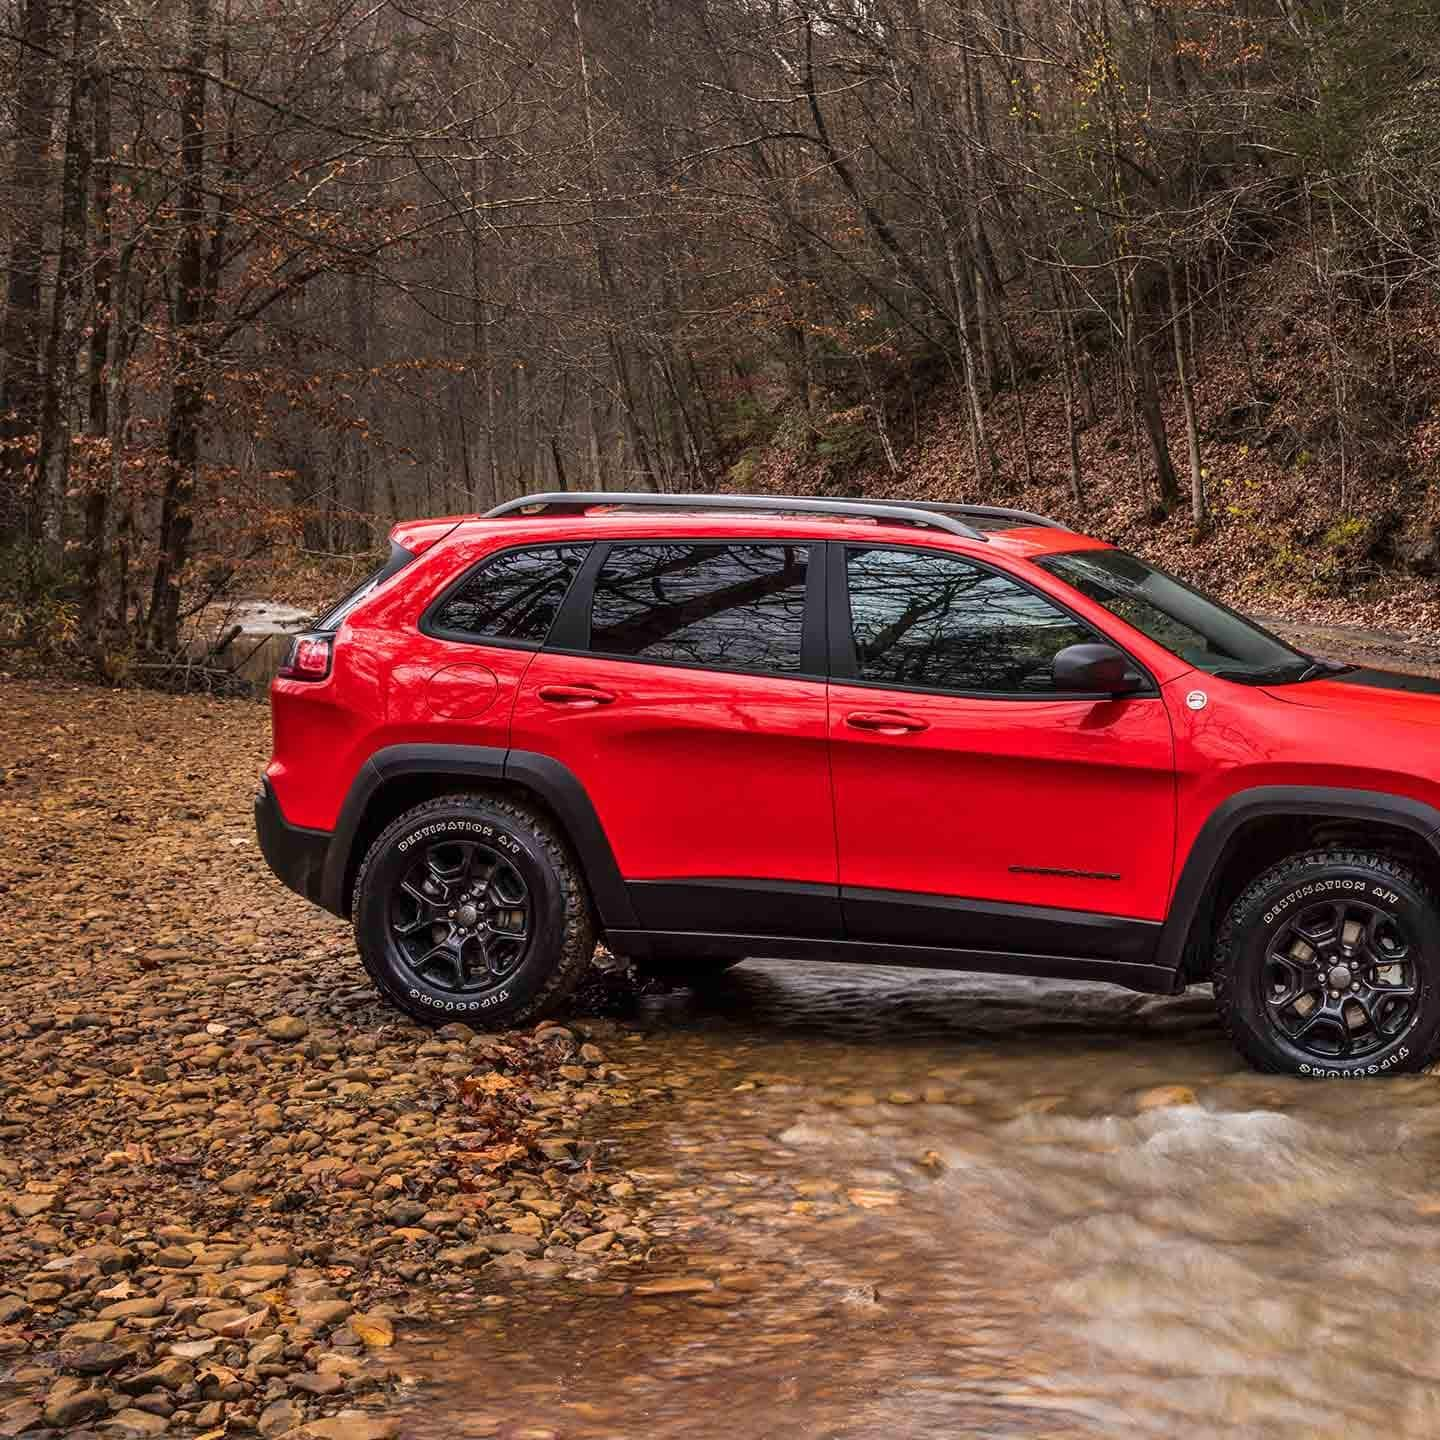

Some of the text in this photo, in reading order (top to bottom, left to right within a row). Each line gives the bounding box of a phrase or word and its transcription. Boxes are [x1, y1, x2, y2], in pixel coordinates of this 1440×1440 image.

[398, 821, 520, 854] DESTINATION A/T
[1263, 880, 1399, 924] DESTINATION A/T
